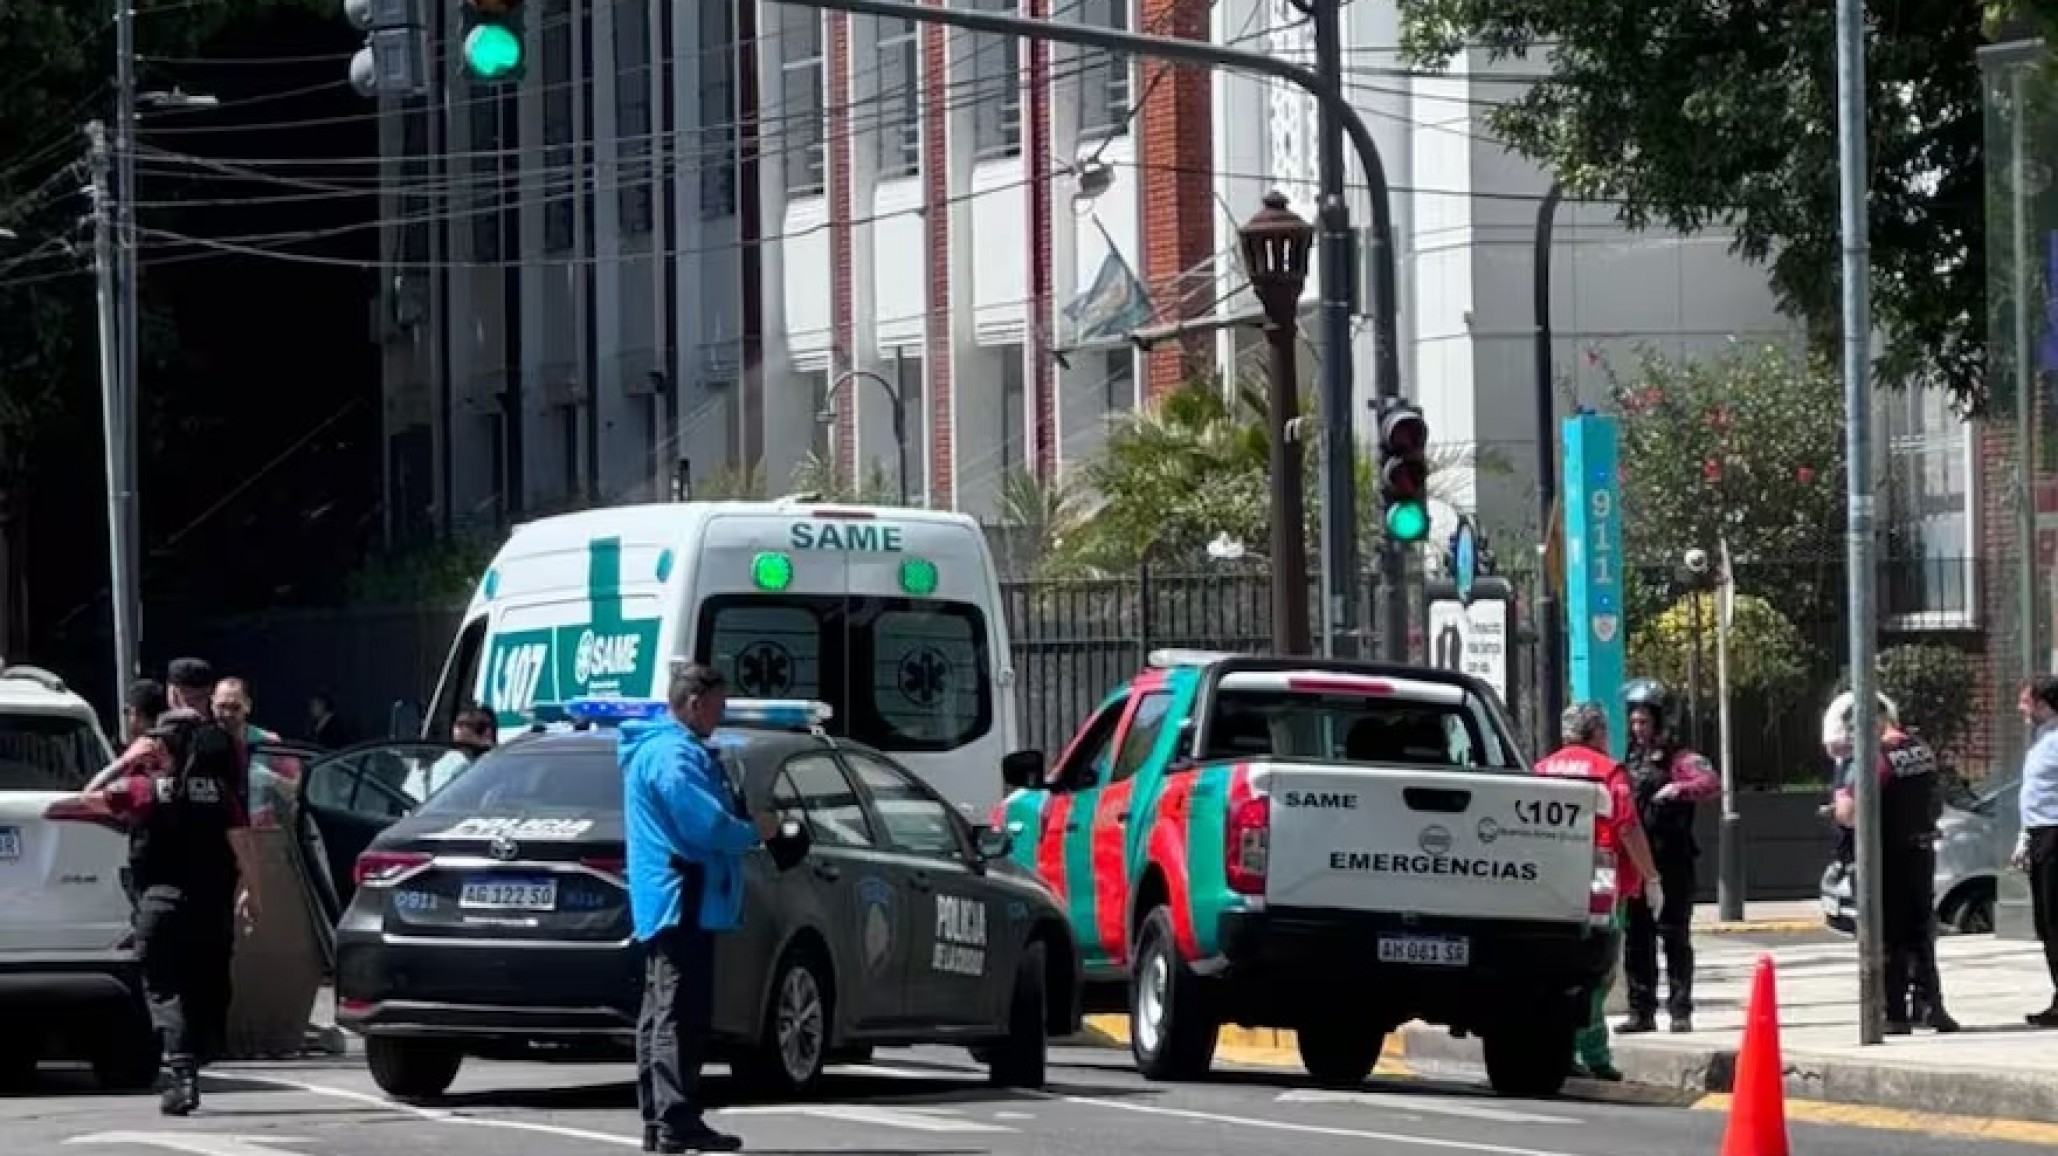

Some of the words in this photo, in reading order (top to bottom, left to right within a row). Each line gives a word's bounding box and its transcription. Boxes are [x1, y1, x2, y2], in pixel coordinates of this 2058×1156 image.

[790, 522, 902, 552] SAME
[1592, 489, 1613, 585] 911
[590, 634, 641, 676] SAME
[503, 643, 548, 712] 107
[1285, 791, 1358, 809] SAME
[1528, 800, 1581, 827] 107
[1330, 851, 1537, 881] EMERGENCIAS
[936, 895, 987, 945] POLICIA
